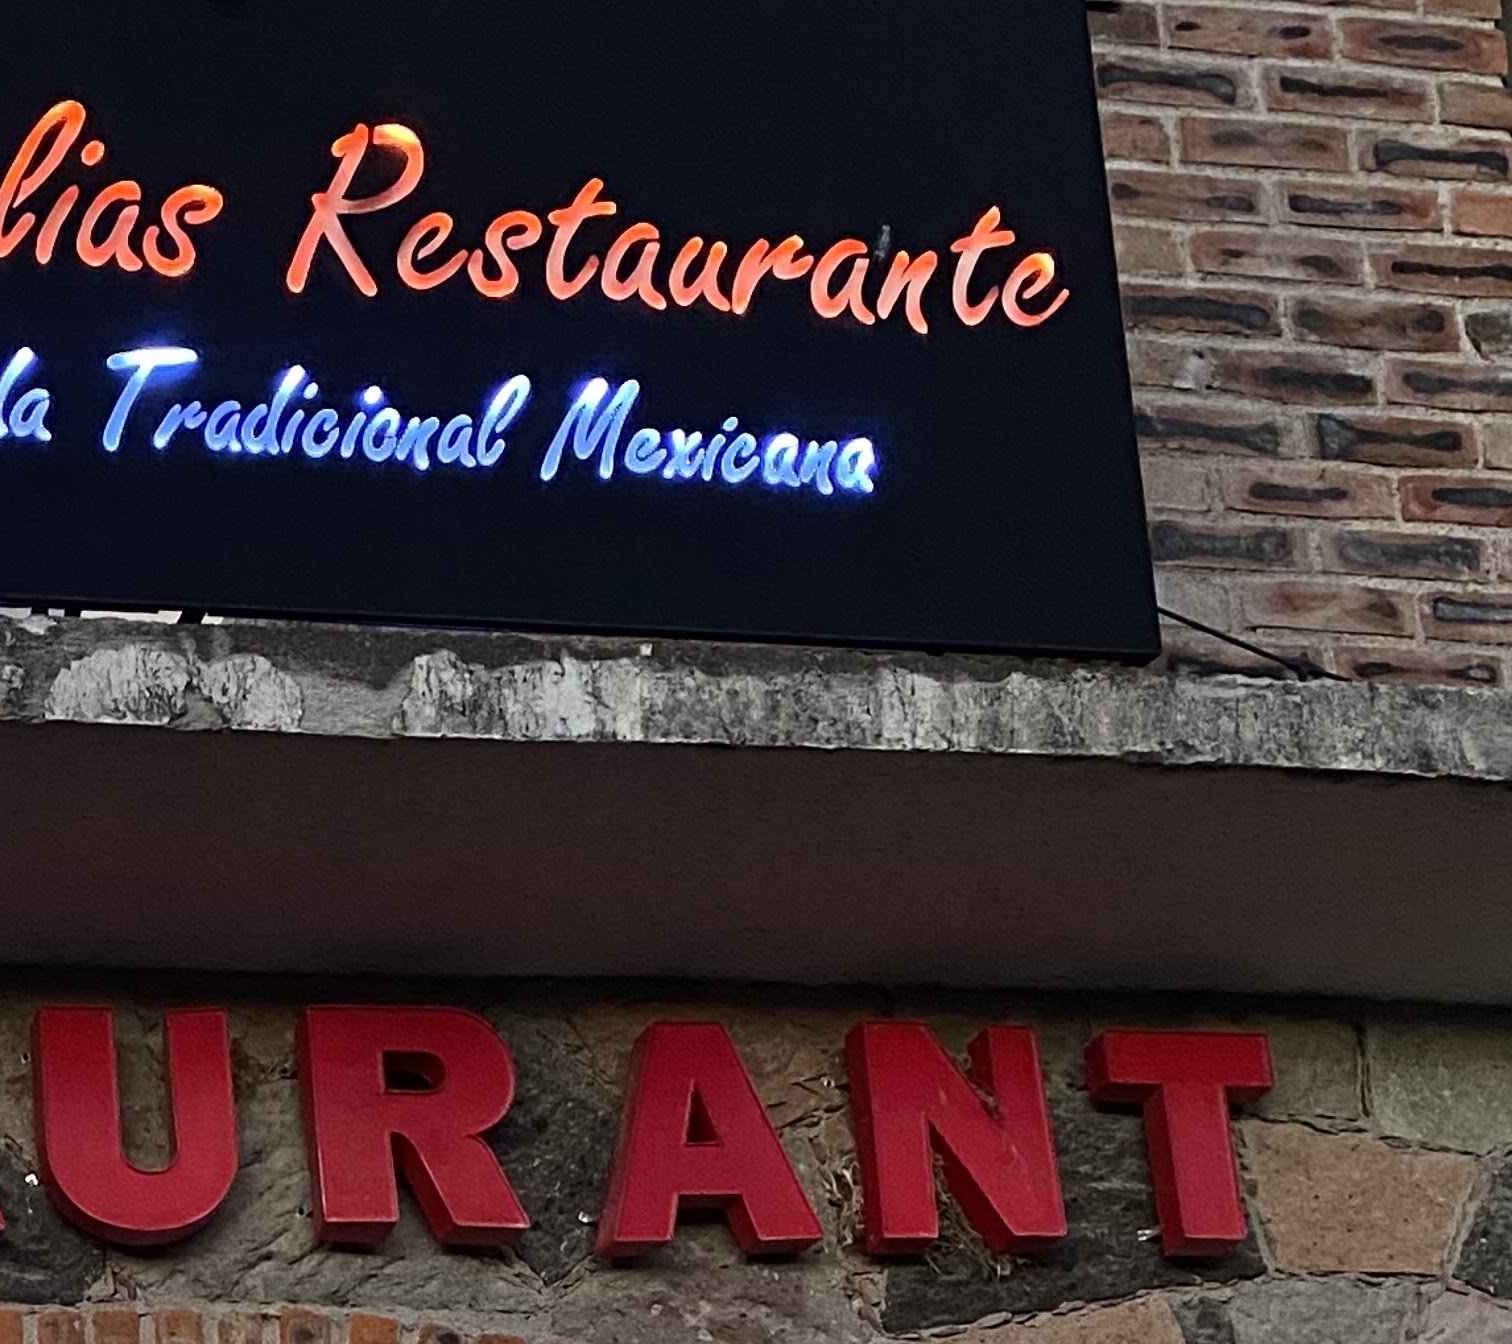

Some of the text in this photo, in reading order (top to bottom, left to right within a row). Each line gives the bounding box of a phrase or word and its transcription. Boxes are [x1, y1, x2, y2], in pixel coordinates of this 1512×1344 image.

[284, 121, 1071, 336] Restaurante
[101, 340, 531, 470] Tradicional
[539, 376, 880, 496] Mexicana
